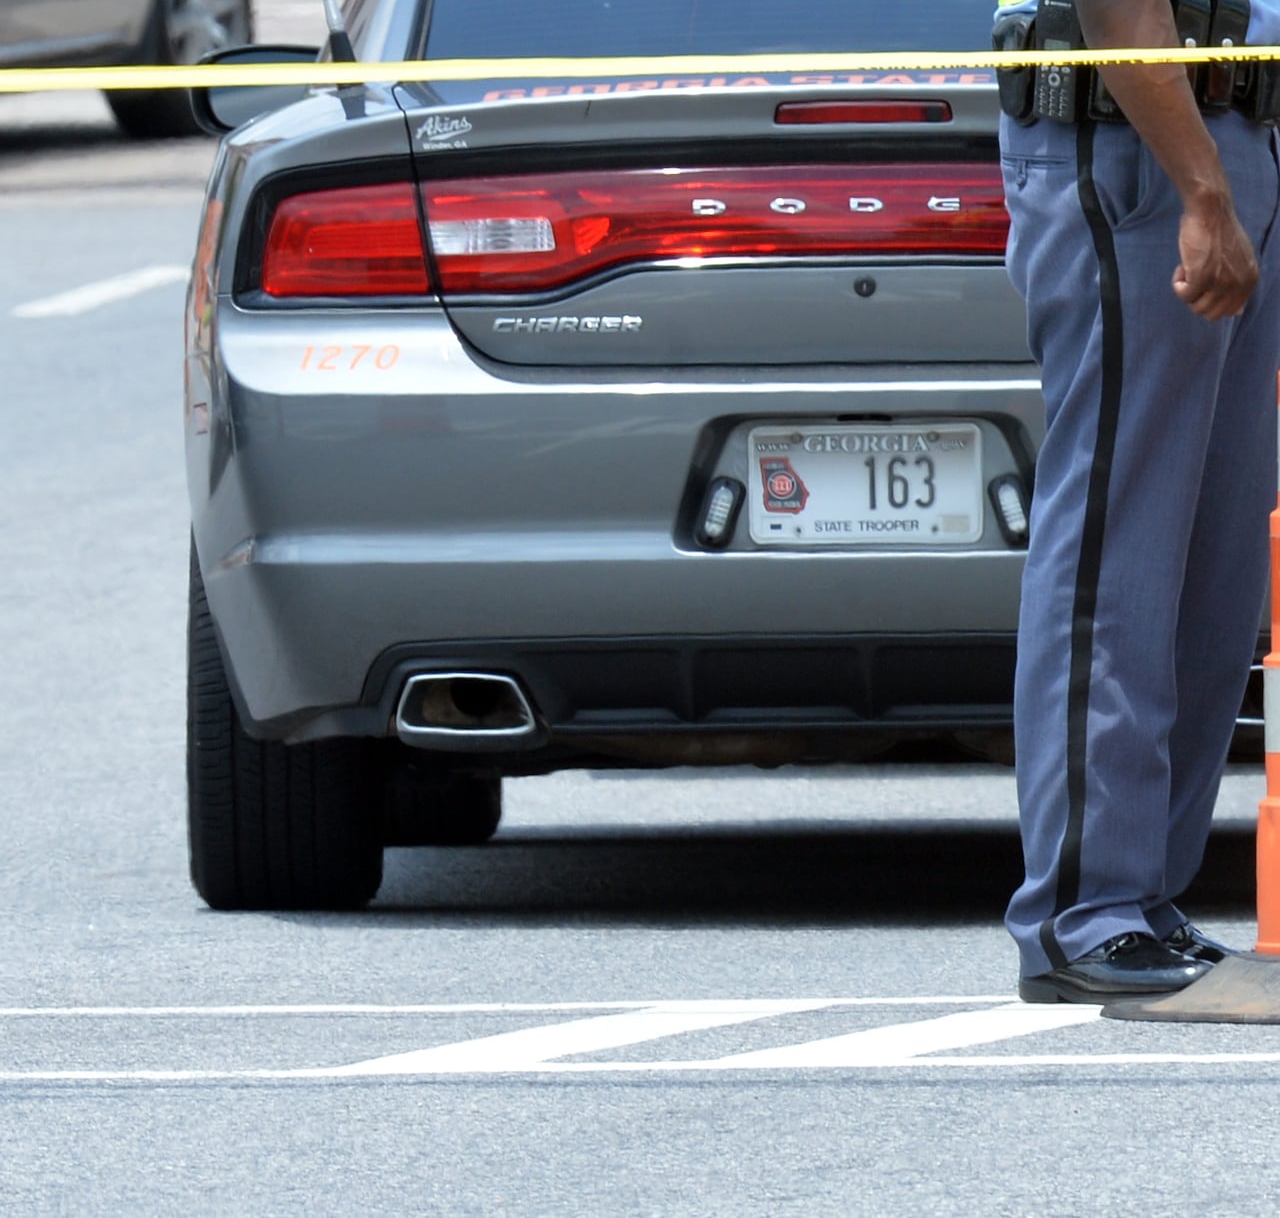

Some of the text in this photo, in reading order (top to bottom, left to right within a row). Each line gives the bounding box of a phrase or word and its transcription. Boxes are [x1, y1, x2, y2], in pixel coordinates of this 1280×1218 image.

[416, 116, 472, 140] Akins
[493, 315, 643, 333] CHARGER
[299, 344, 401, 371] 1270
[803, 434, 930, 454] GEORGIA
[863, 455, 937, 511] 163
[814, 519, 920, 533] STATE TROOPER
